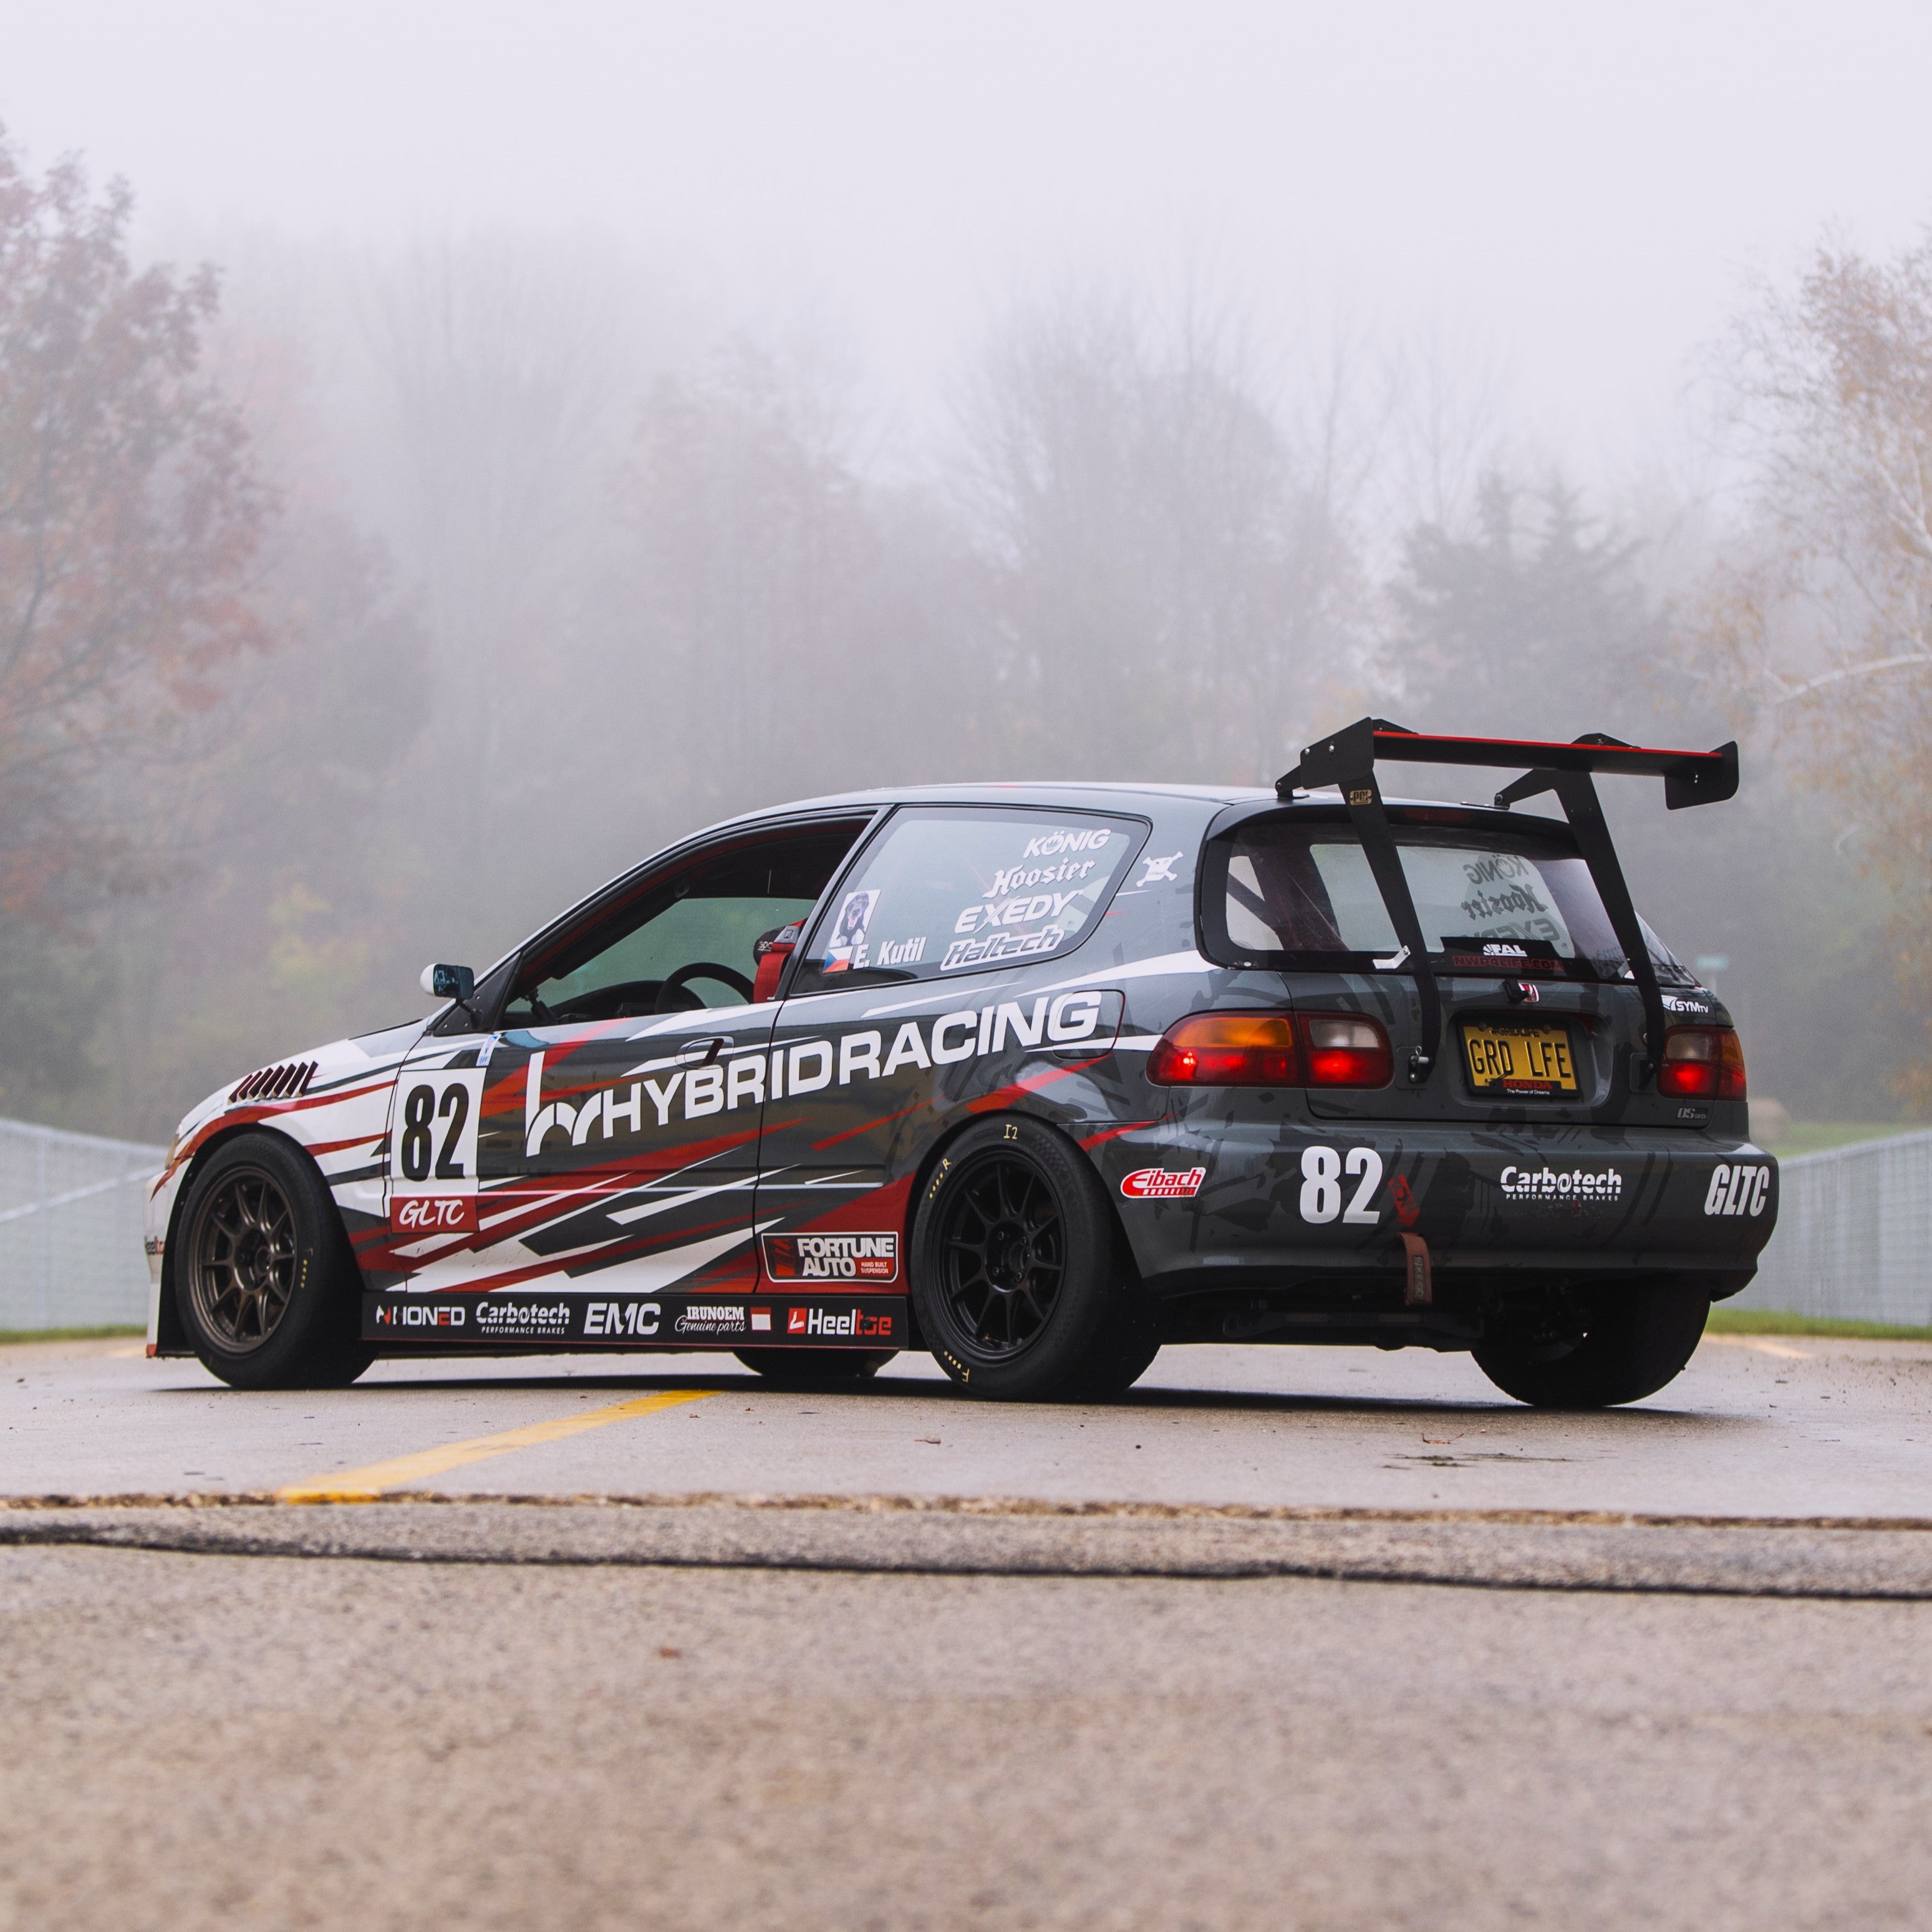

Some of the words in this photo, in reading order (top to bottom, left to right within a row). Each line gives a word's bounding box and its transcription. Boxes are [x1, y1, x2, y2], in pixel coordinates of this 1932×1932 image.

[1023, 829, 1111, 858] KÖNIG
[983, 857, 1096, 898] Hoosier
[954, 889, 1084, 934] EXEDY
[853, 944, 871, 969] E.
[876, 937, 927, 965] Kutil
[941, 925, 1064, 970] Haltech
[602, 991, 1102, 1139] HYBRIDRACING
[1469, 1038, 1514, 1076] GRD
[1525, 1041, 1572, 1078] LFE
[1502, 1080, 1553, 1090] HONDA
[401, 1083, 470, 1182] 82
[1123, 1169, 1203, 1197] Eibach
[1300, 1146, 1383, 1224] 82
[1500, 1166, 1622, 1194] Carbotech
[1704, 1164, 1770, 1217] GLTC
[399, 1199, 465, 1229] GLTC
[797, 1237, 894, 1258] FORTUNE
[802, 1257, 856, 1277] AUTO
[476, 1302, 570, 1325] Carbotech
[583, 1303, 660, 1335] EMC
[675, 1315, 717, 1335] Genuine
[716, 1320, 746, 1335] parts
[687, 1306, 745, 1320] IRUNOEM
[481, 1326, 534, 1334] PERFORMANCE
